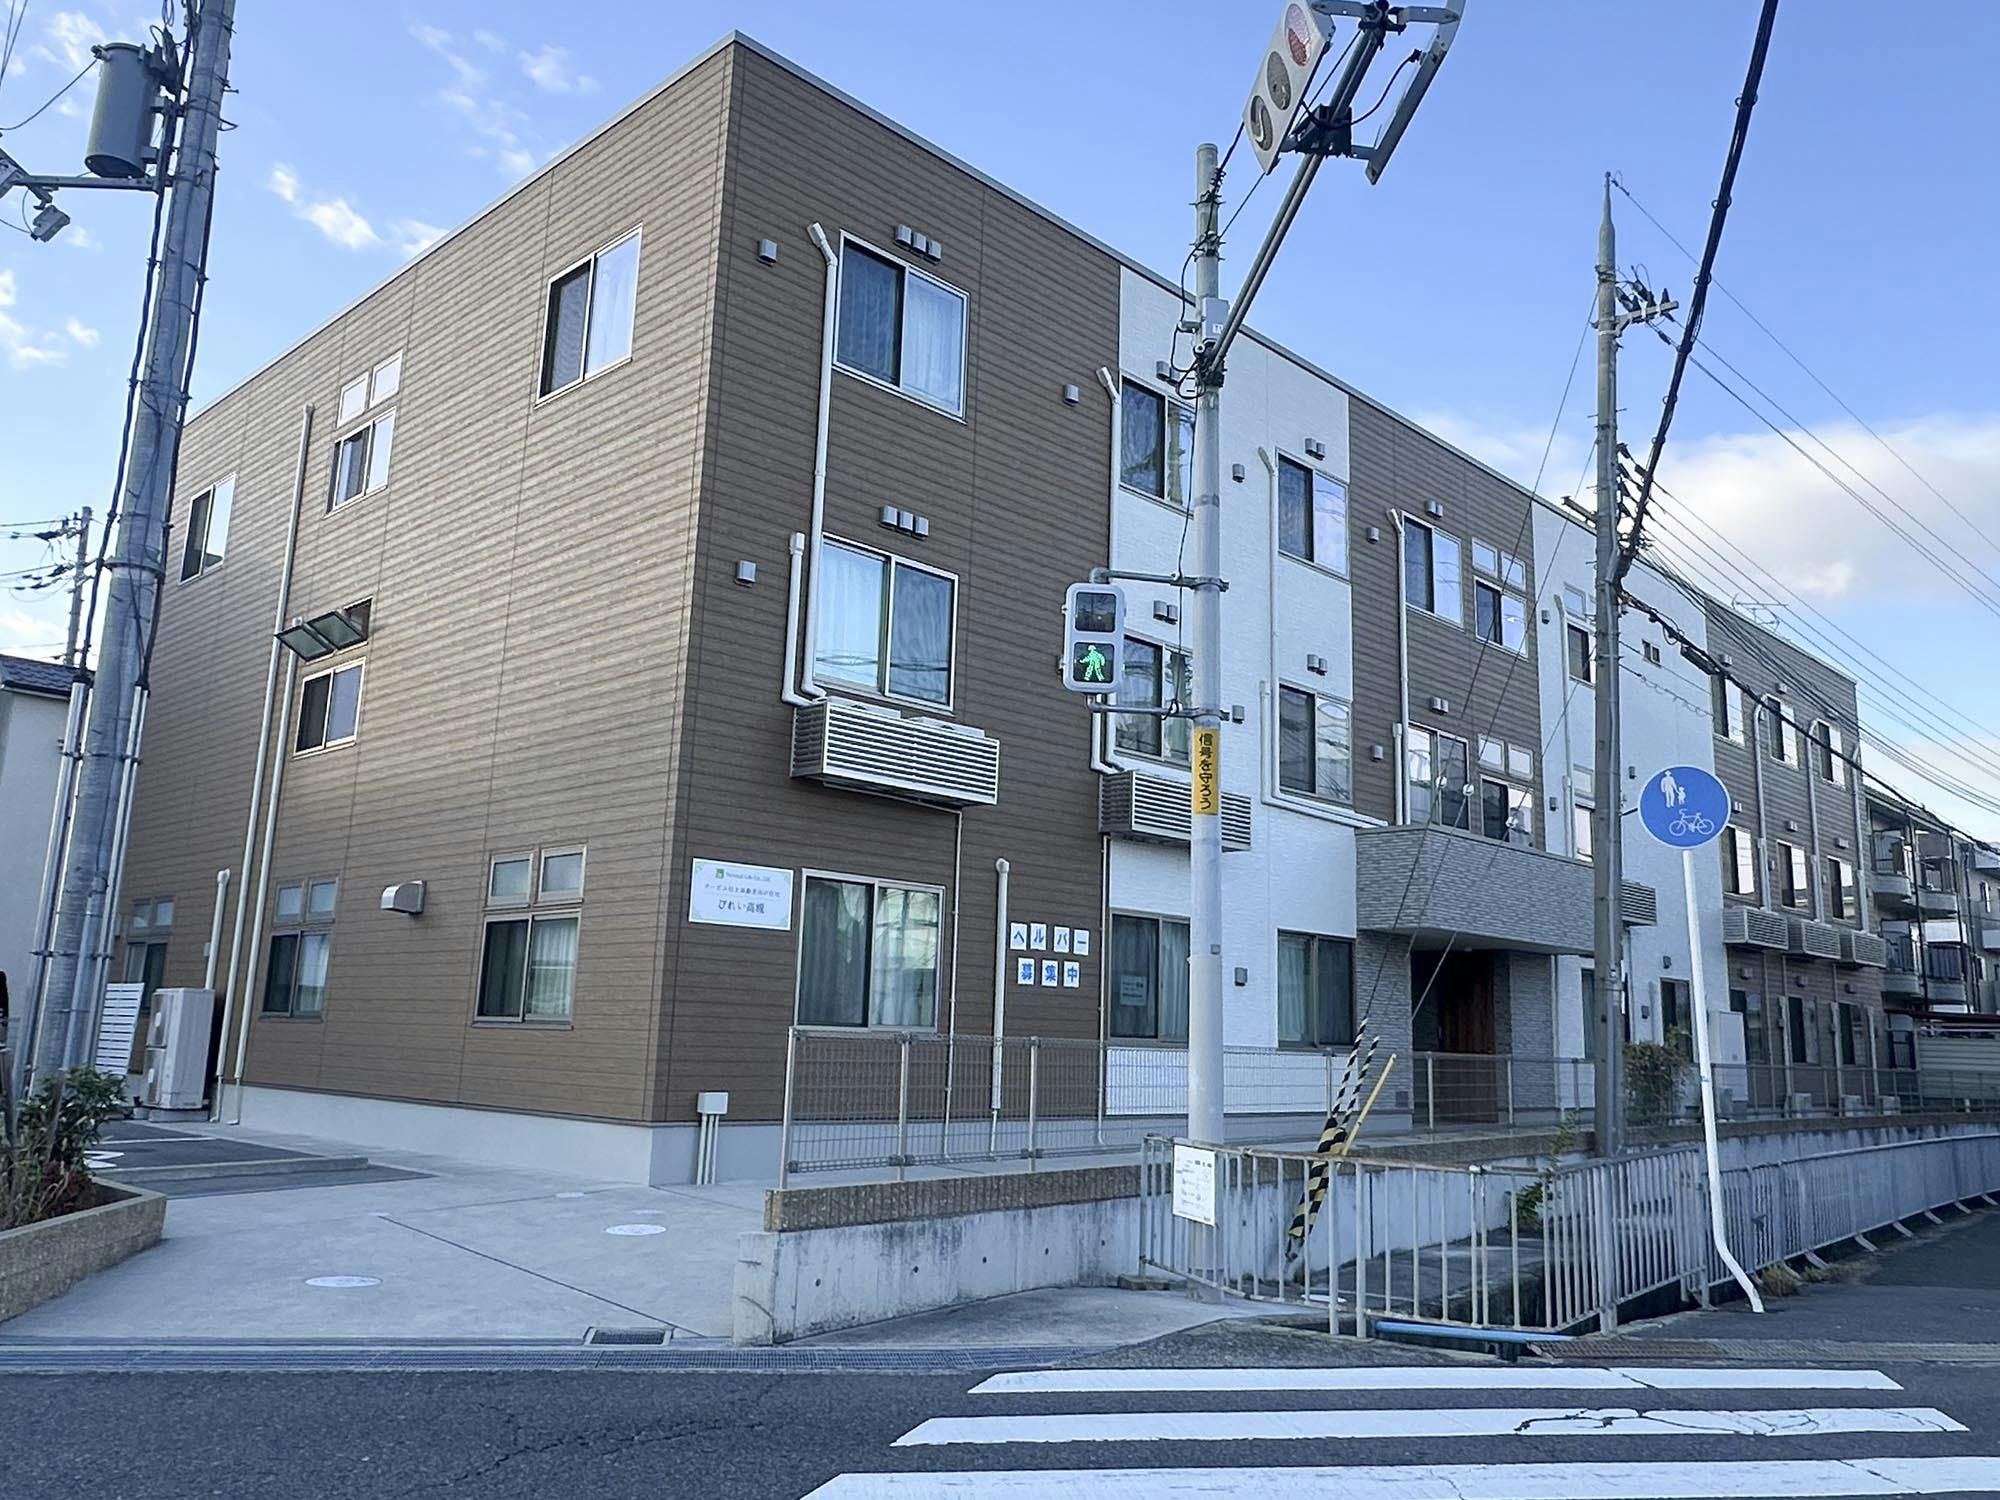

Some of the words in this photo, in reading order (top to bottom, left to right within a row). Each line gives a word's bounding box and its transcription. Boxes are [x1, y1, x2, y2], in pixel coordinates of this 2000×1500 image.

[1199, 733, 1213, 810] 信号を守ろう
[1021, 963, 1078, 982] 募集中
